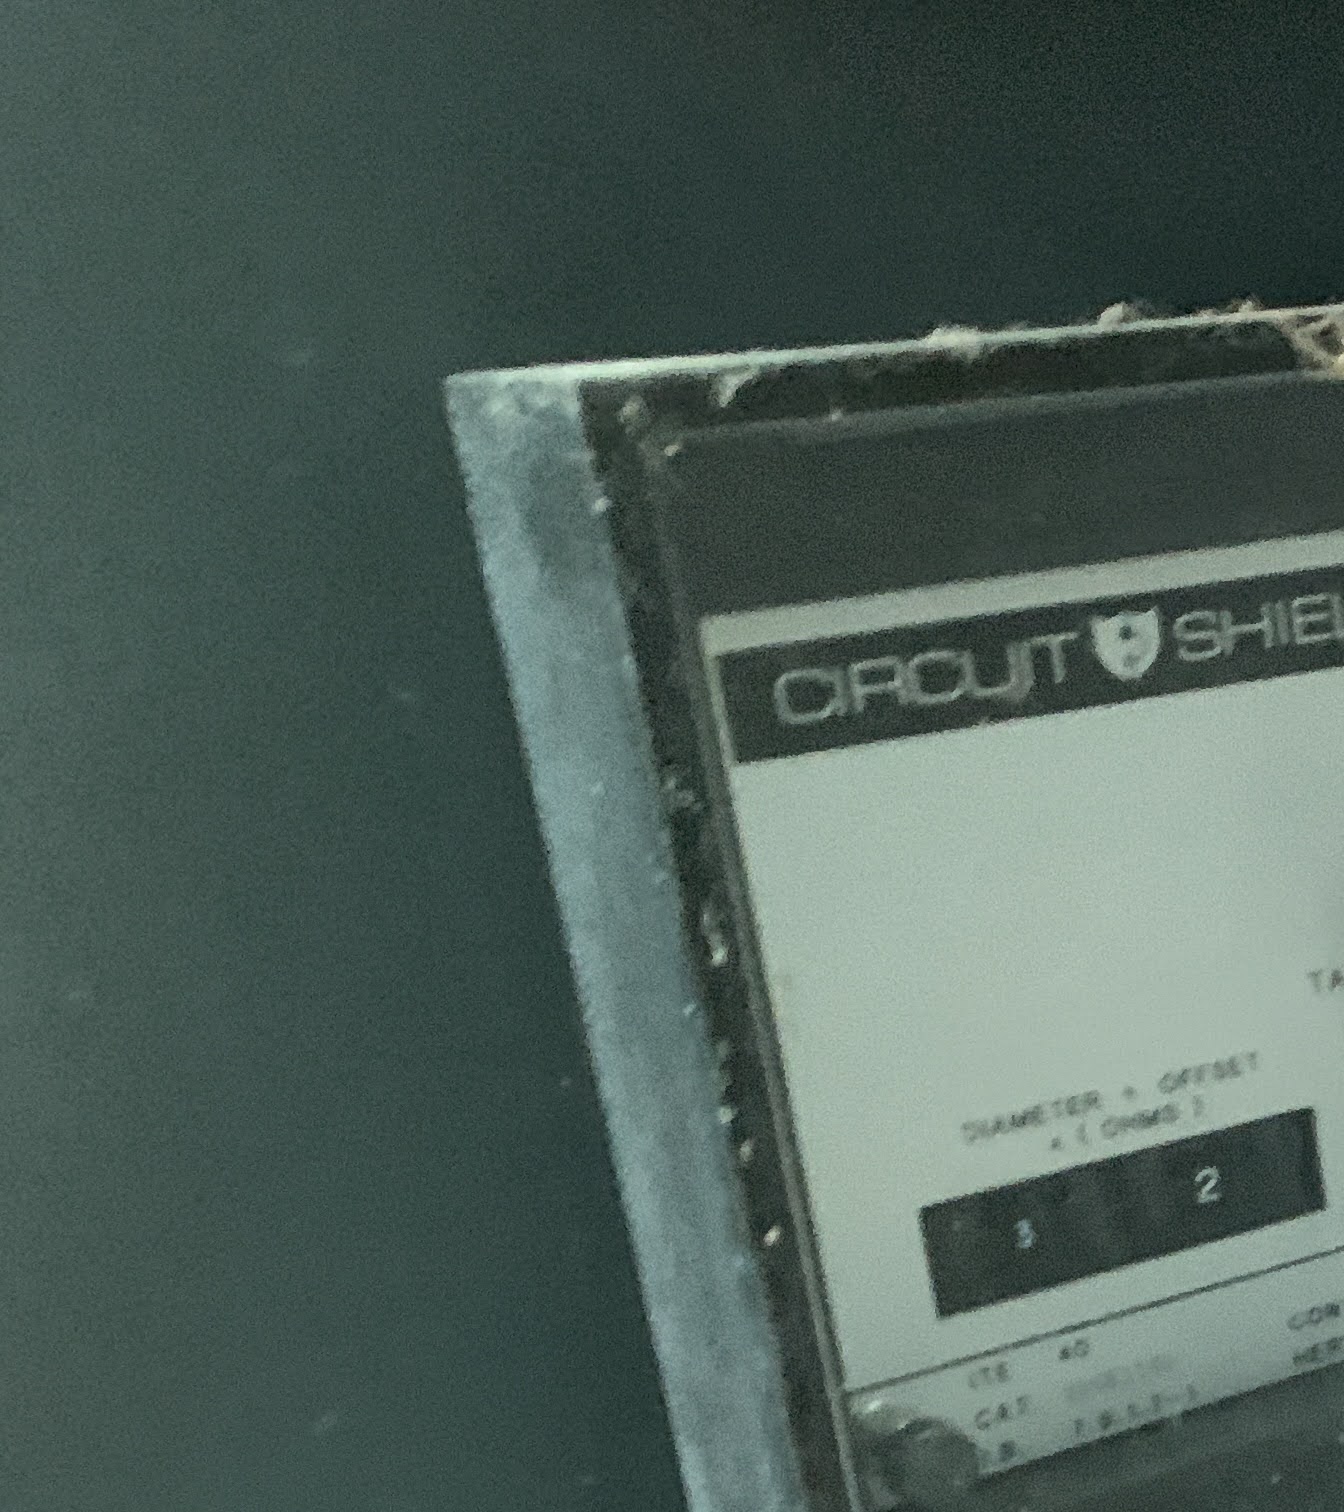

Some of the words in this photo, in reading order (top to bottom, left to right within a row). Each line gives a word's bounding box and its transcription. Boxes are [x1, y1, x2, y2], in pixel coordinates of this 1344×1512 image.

[772, 630, 1080, 726] CIRCUIT
[960, 1090, 1101, 1145] DIAMETER
[1158, 1051, 1259, 1094] OFFSET
[1101, 1103, 1182, 1140] OHMS
[1194, 1166, 1221, 1204] 2
